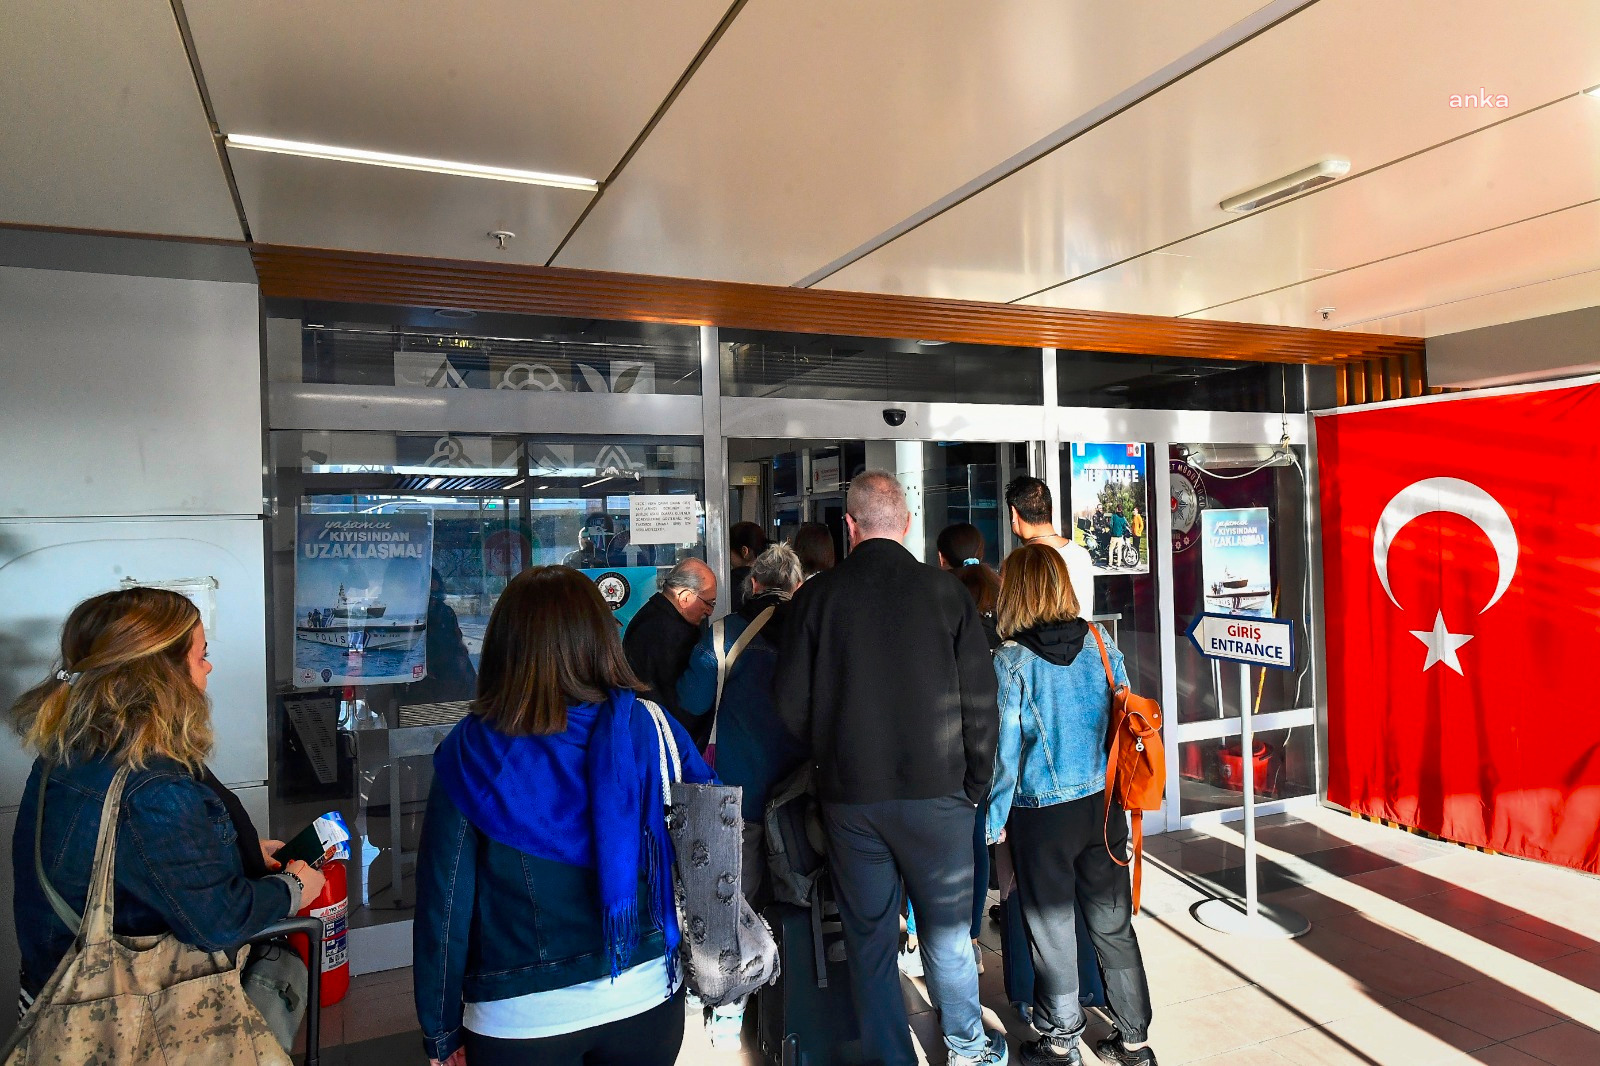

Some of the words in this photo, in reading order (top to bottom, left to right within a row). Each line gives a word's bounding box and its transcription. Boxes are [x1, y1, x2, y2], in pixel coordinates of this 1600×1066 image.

[329, 531, 410, 542] KIYISINDAN
[304, 543, 423, 559] UZAKLAŞMA!
[1227, 623, 1262, 643] GİRİŞ
[1211, 637, 1283, 659] ENTRANCE
